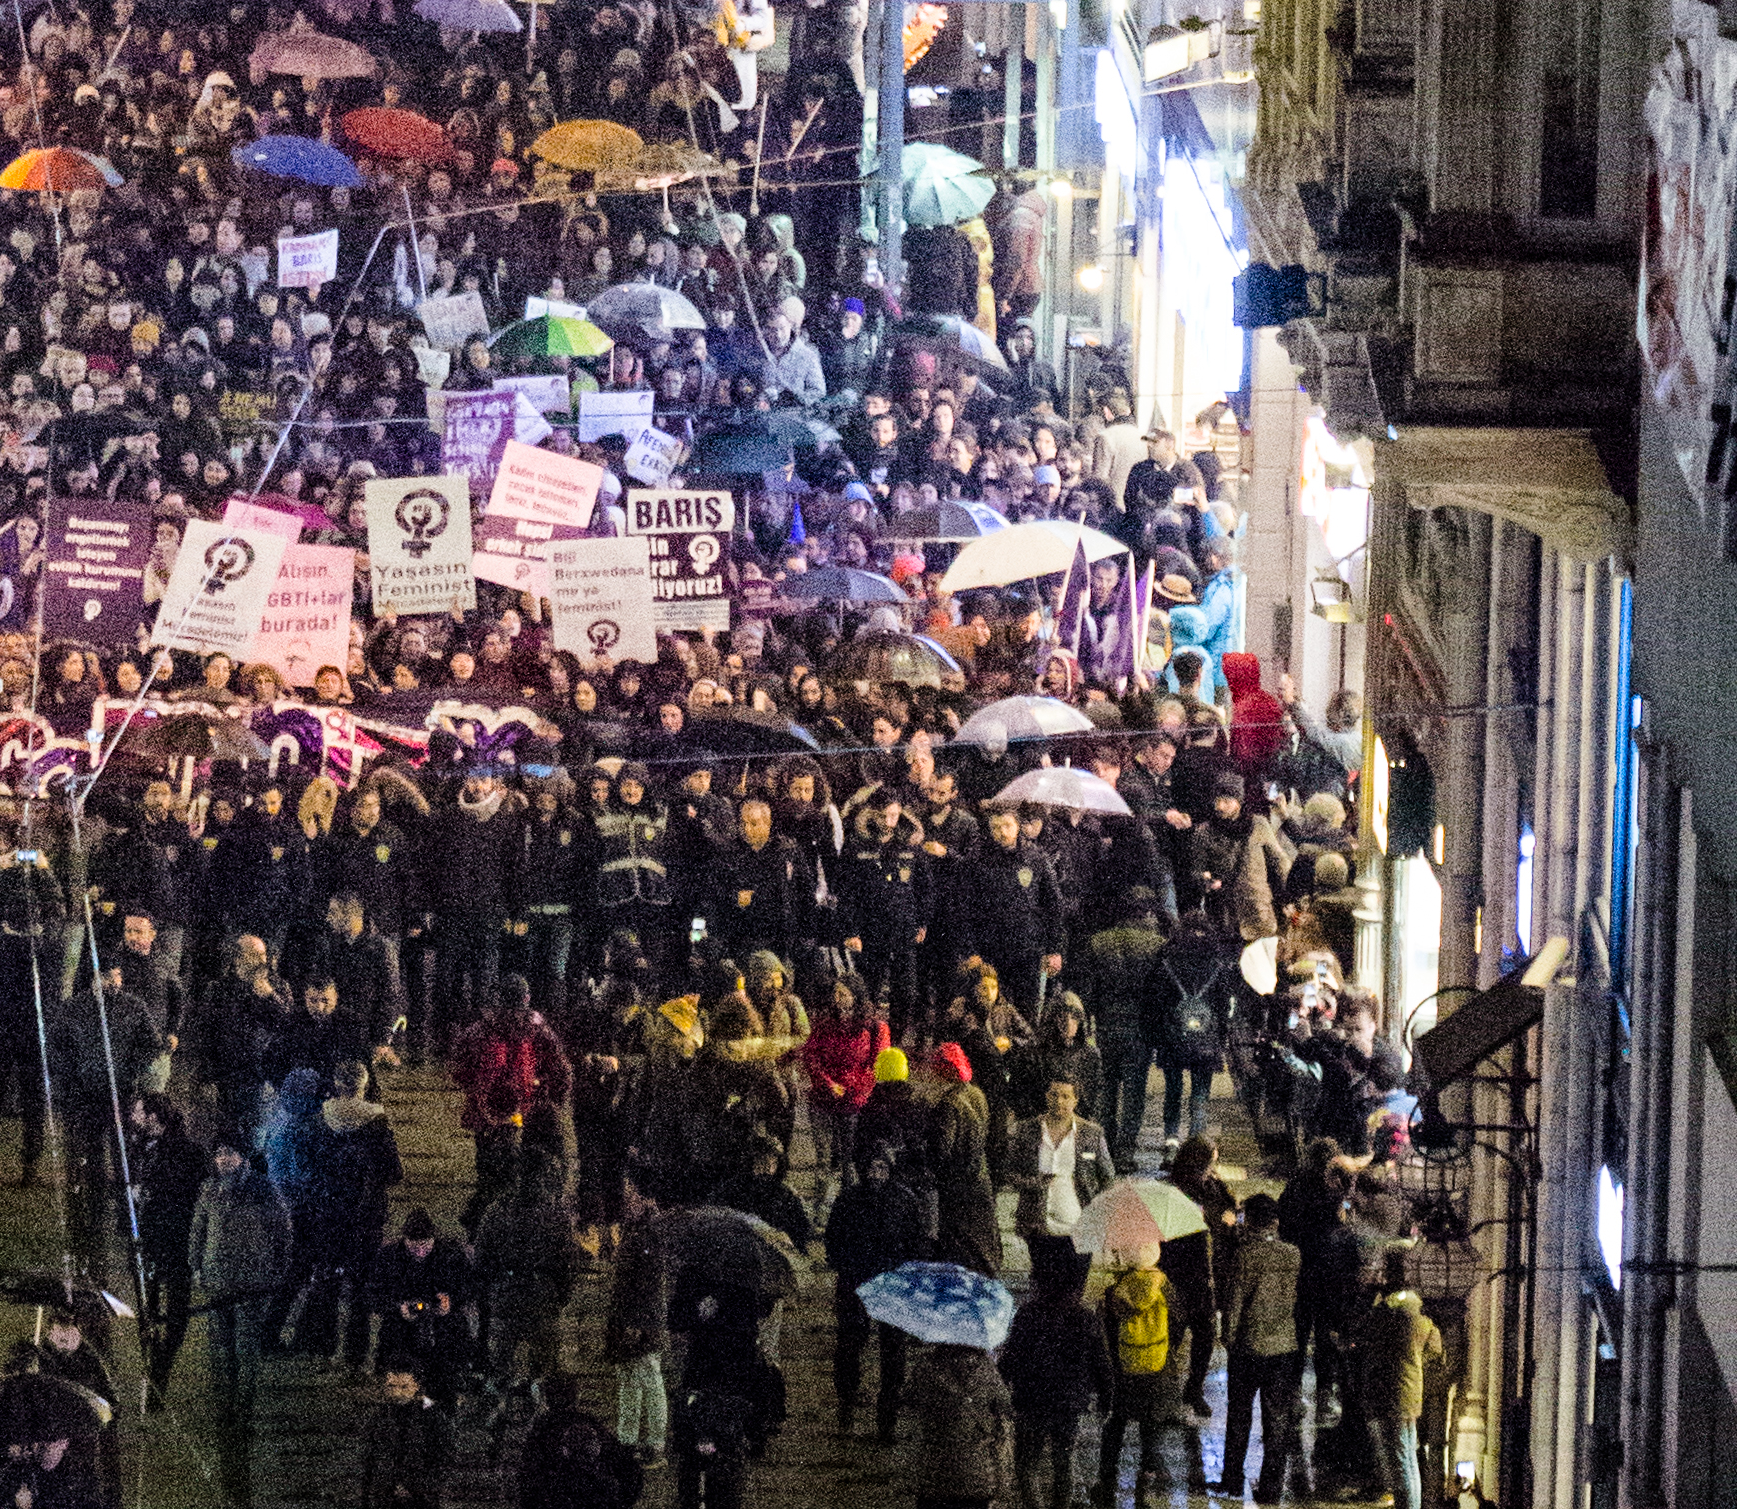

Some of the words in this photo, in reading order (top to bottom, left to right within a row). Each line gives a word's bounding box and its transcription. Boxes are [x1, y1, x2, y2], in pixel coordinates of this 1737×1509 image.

[633, 495, 723, 531] BARIŞ
[374, 561, 468, 582] Yaşasın
[266, 588, 347, 609] GBTİ+lar
[378, 578, 472, 598] Feminist
[261, 614, 339, 635] burada!
